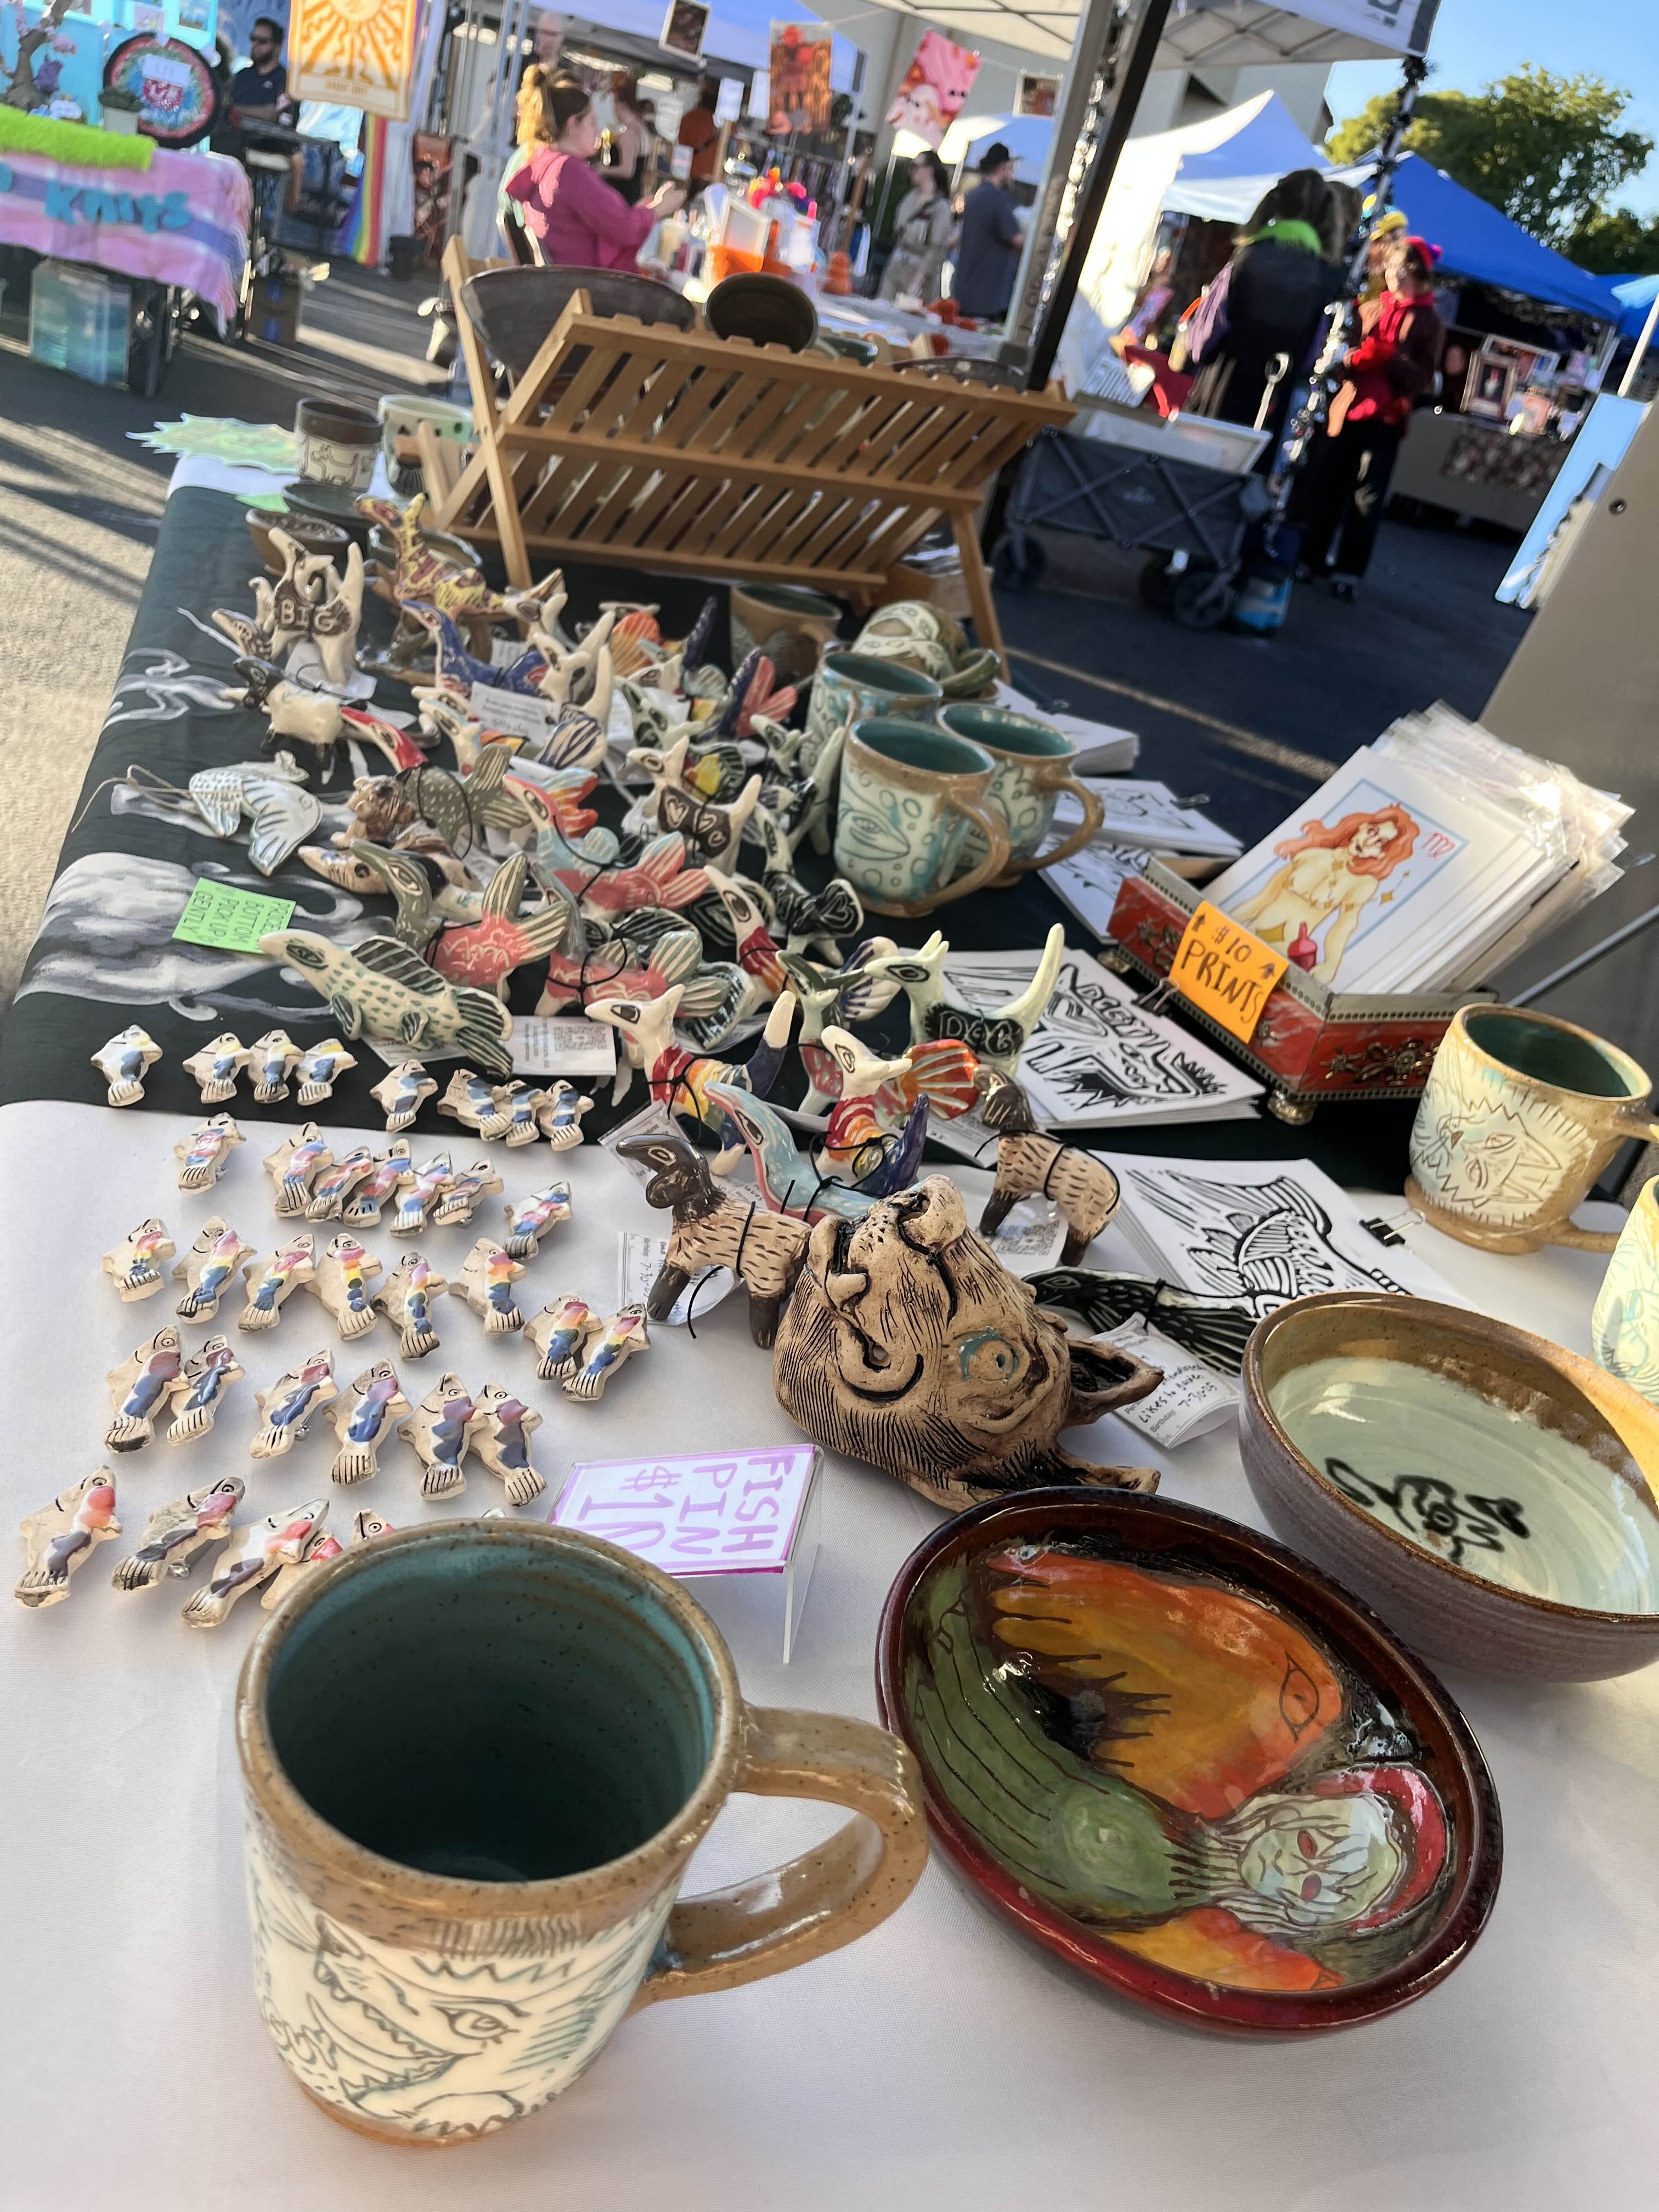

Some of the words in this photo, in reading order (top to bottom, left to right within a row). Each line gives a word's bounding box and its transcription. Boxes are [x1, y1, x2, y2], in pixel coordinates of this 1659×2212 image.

[280, 598, 336, 632] BIG
[181, 890, 213, 934] GENTLY
[210, 922, 229, 937] UP
[214, 897, 239, 922] PICK
[230, 900, 264, 944] BOTTOM
[1211, 926, 1251, 963] $10
[1180, 938, 1263, 1024] PRINTS
[670, 1462, 737, 1555] PIN
[720, 1453, 795, 1554] FISH
